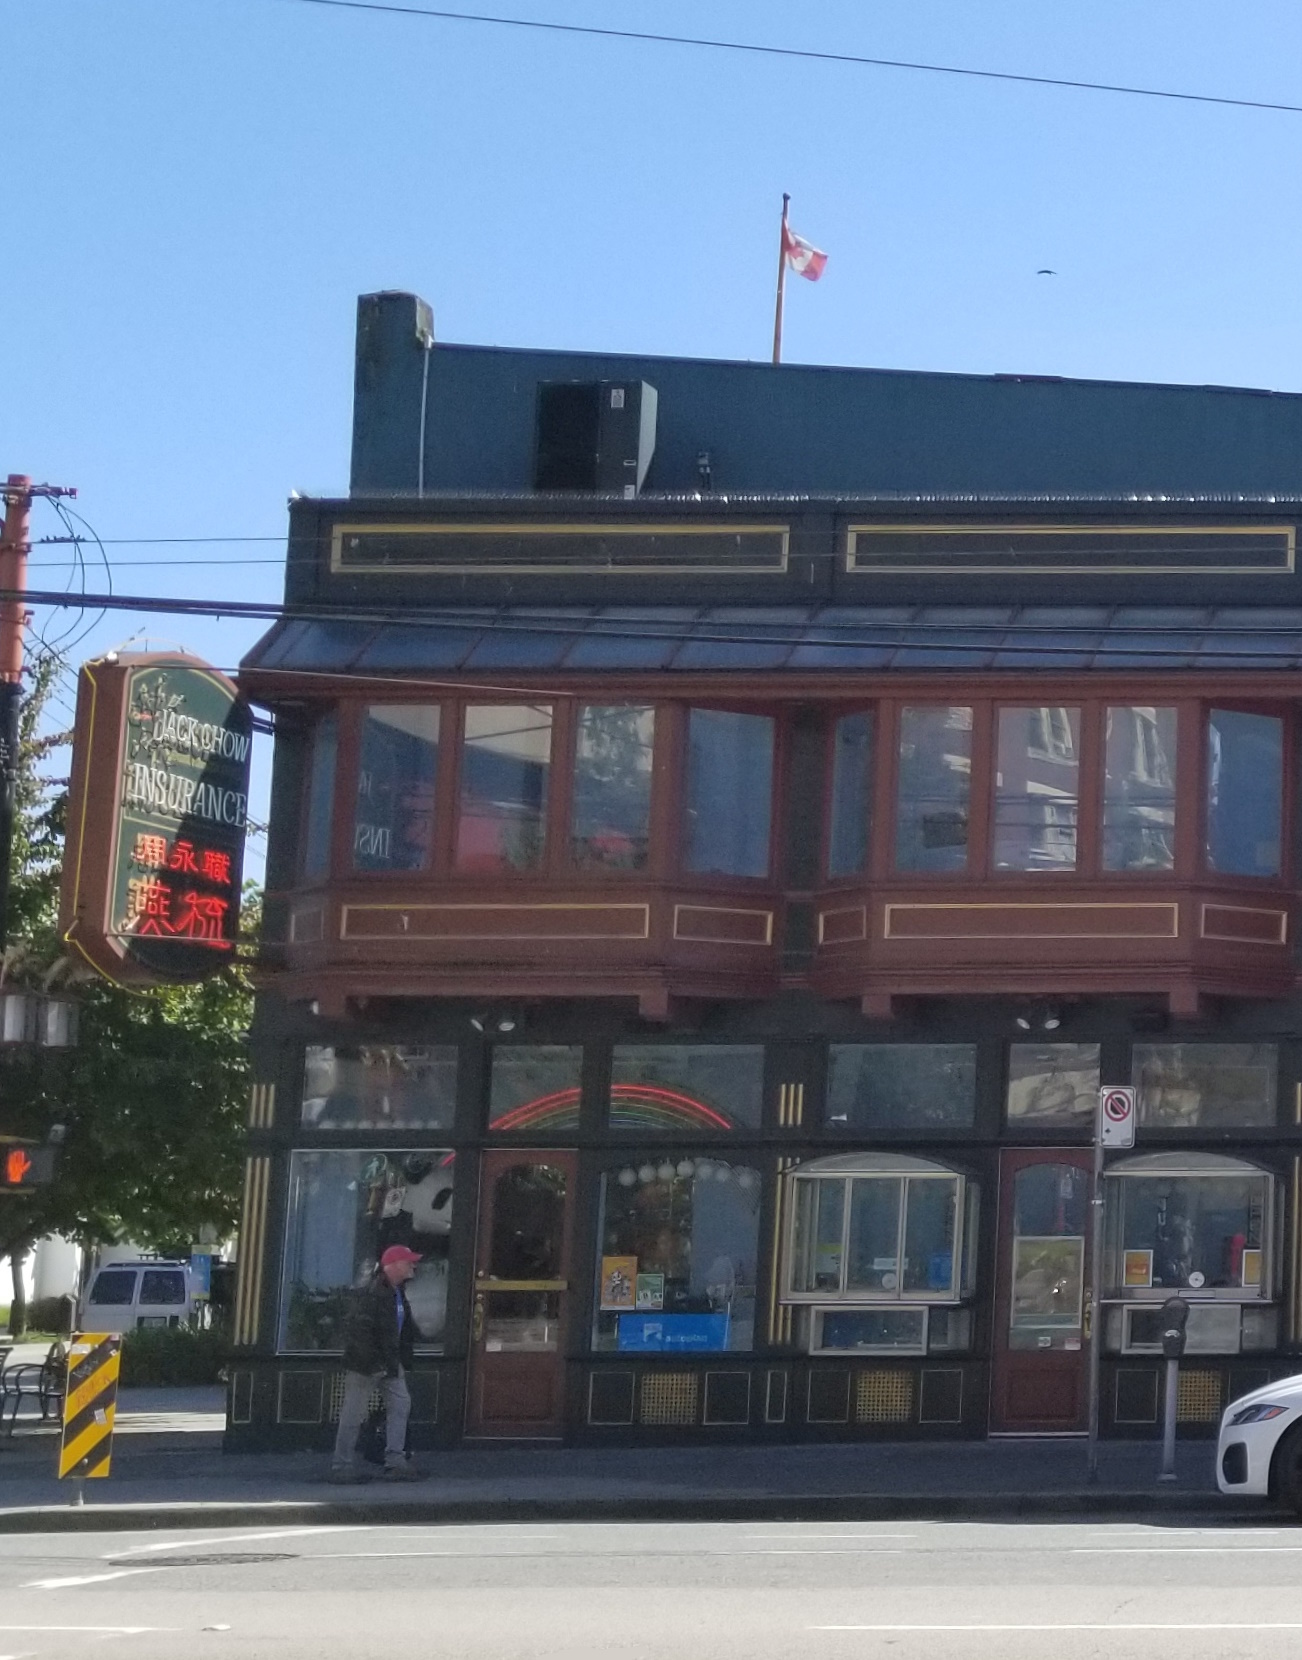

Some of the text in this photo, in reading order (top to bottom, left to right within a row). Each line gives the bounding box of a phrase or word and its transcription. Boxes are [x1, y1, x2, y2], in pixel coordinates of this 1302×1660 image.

[153, 708, 250, 763] JACK CHOW
[130, 762, 248, 828] INSURANCE
